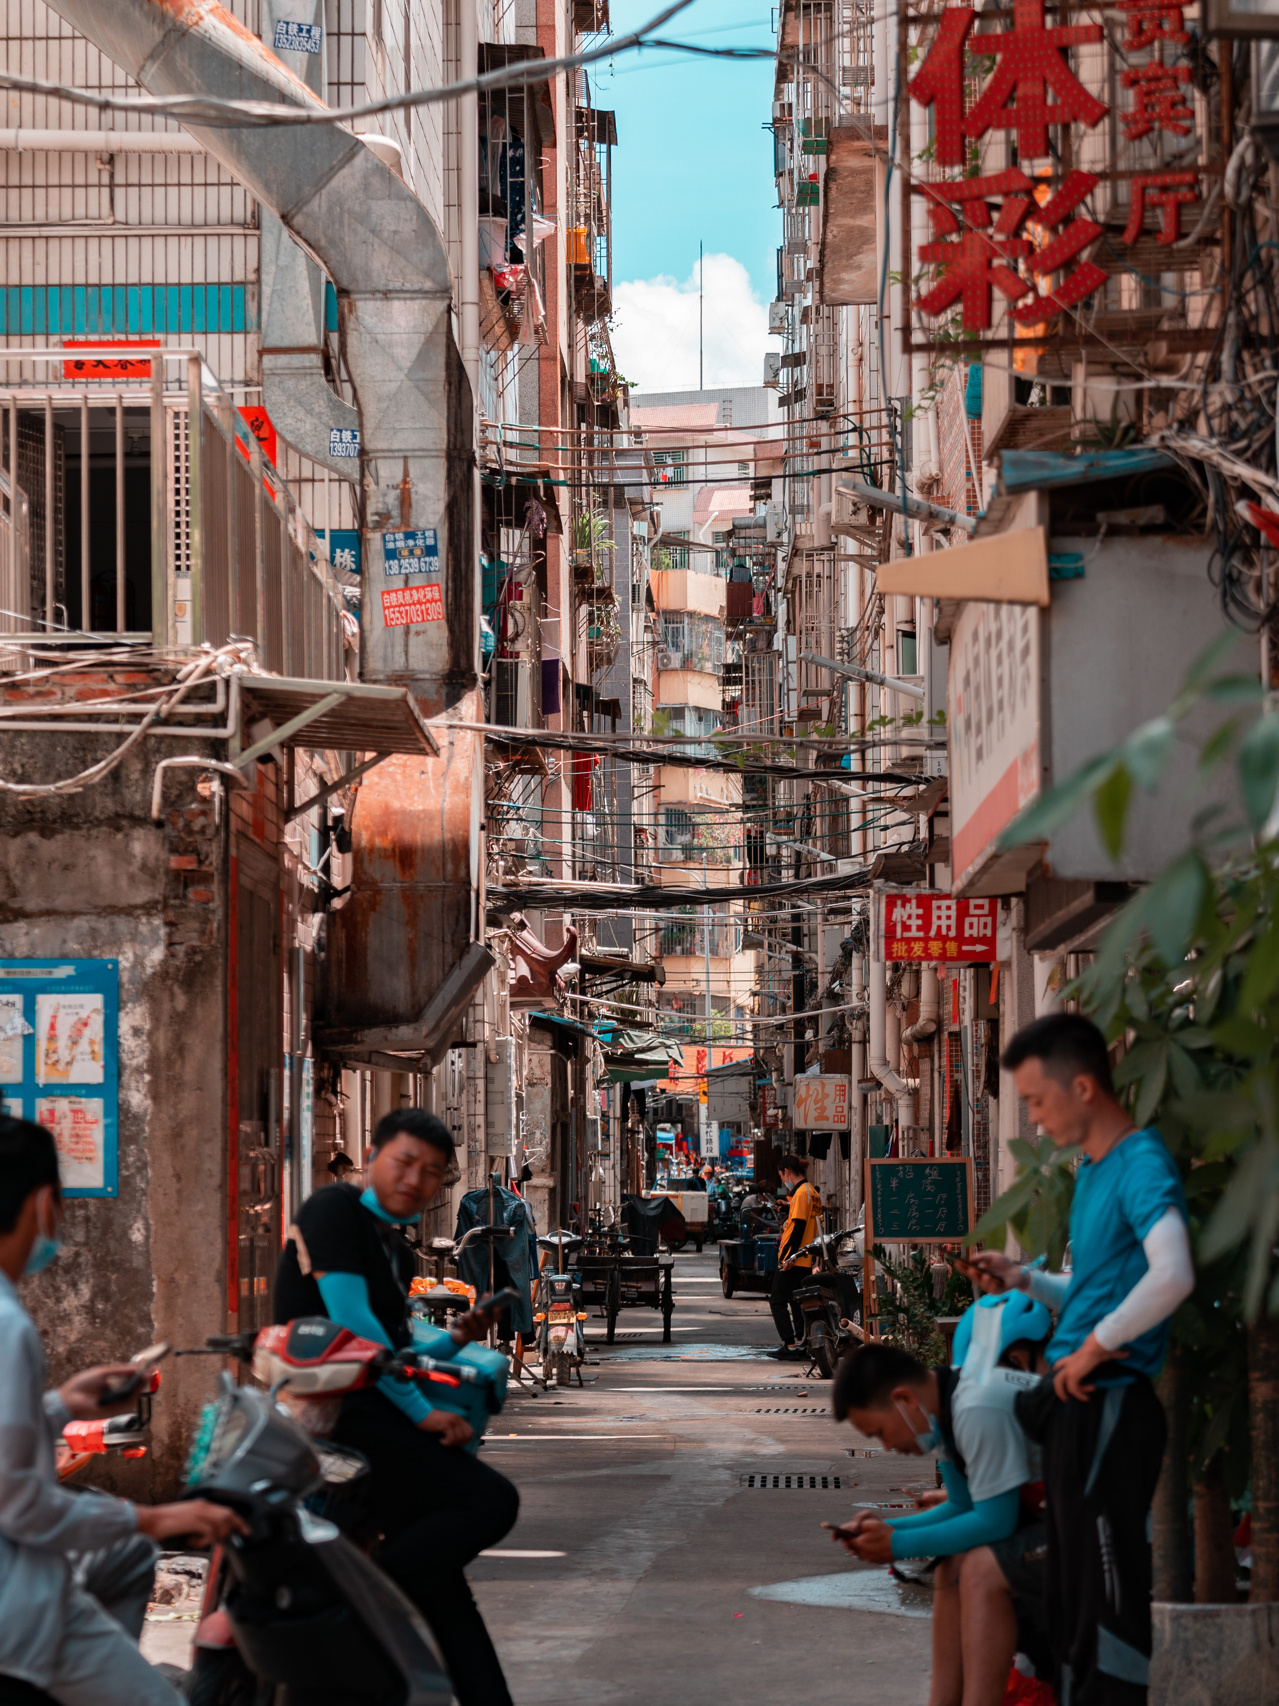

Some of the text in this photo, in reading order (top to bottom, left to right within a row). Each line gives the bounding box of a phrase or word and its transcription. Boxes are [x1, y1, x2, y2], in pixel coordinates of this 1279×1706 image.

[276, 20, 322, 41] 白铁工程
[907, 0, 1110, 330] 体彩
[385, 556, 439, 575] 138 2539 6739
[383, 586, 440, 607] 白铁风机净化环保
[385, 602, 443, 626] 15537031309
[892, 899, 992, 939] 性用品
[891, 941, 958, 957] 批发零售
[796, 1080, 830, 1126] 性
[833, 1084, 846, 1124] 用品
